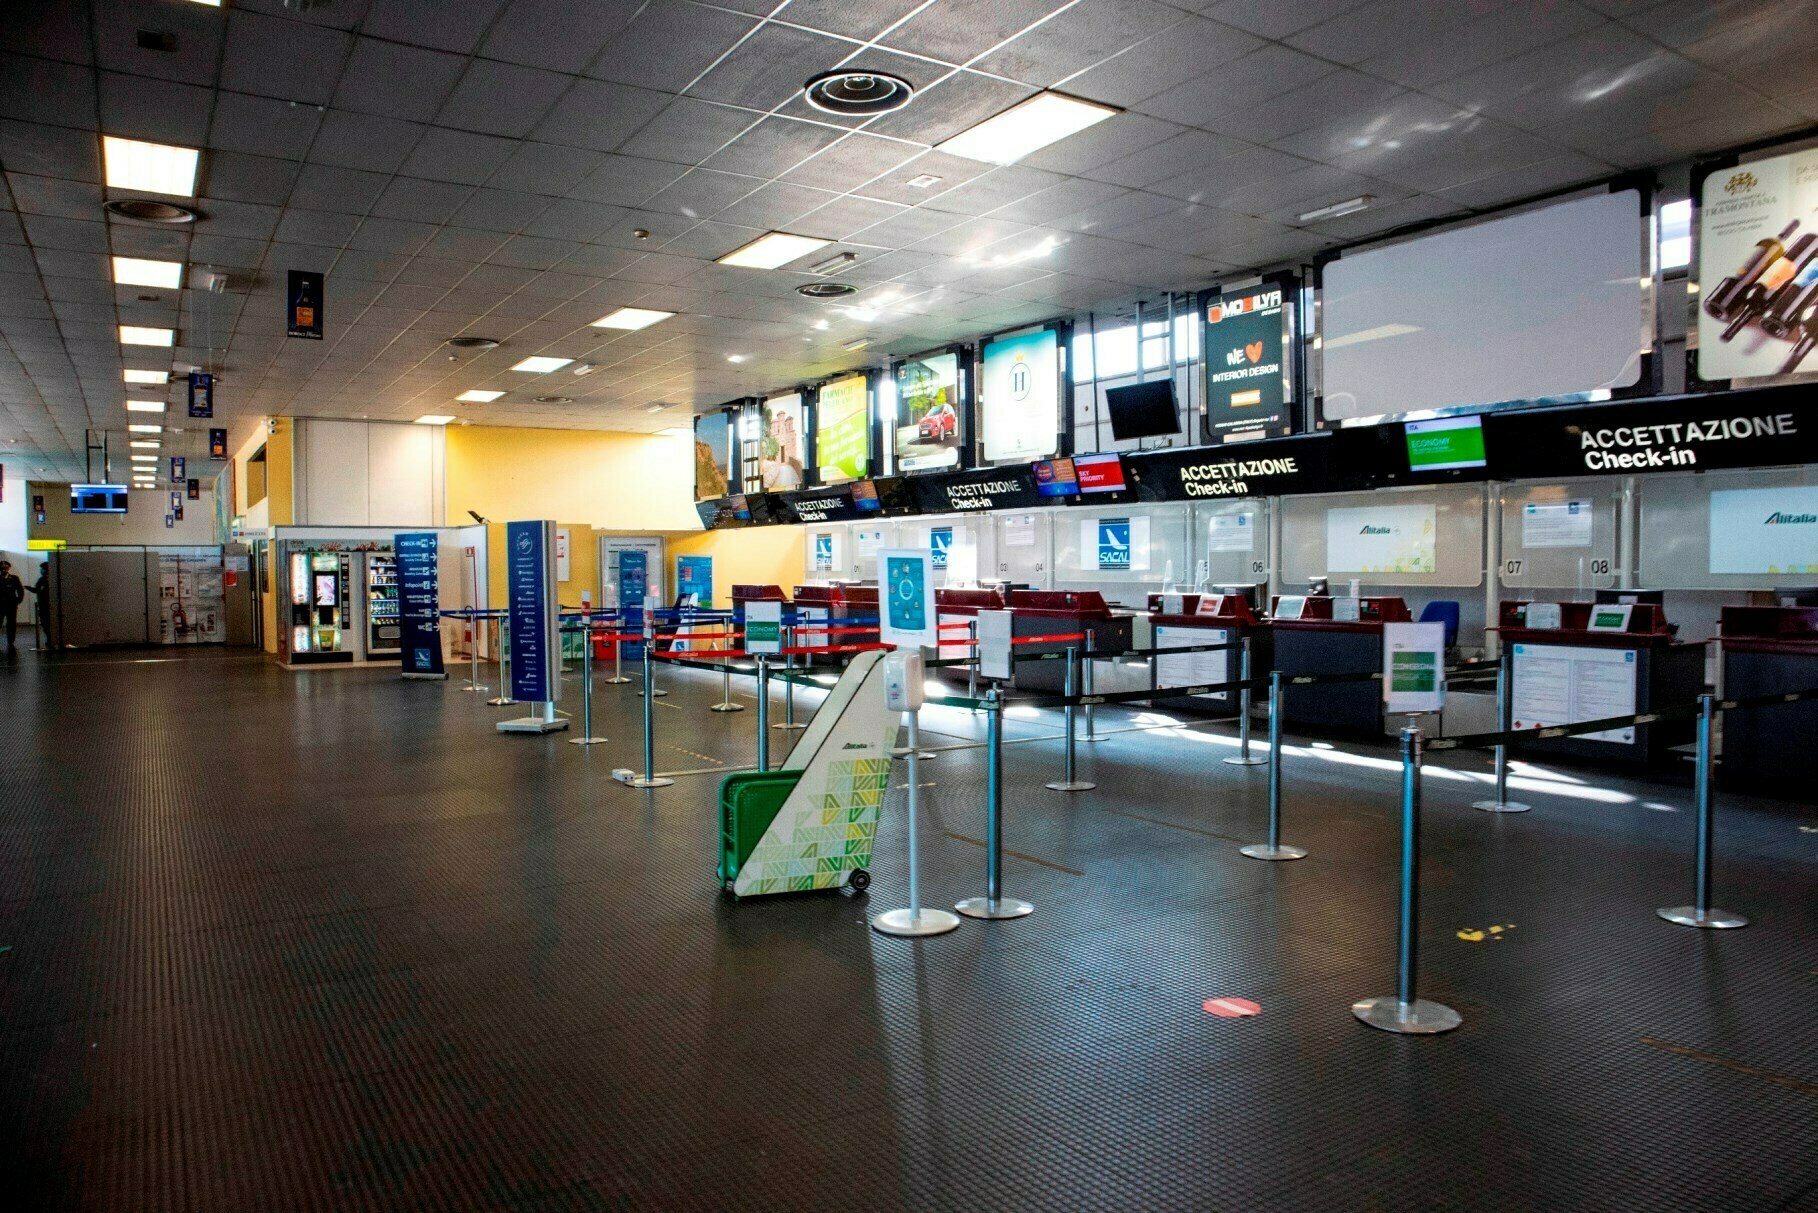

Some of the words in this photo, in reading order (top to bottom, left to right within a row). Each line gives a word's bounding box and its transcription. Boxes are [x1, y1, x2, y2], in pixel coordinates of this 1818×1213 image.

[1226, 348, 1245, 366] WE
[1213, 368, 1248, 383] INTERIOR
[1249, 363, 1279, 378] DESIGN
[1581, 413, 1797, 449] ACCETTAZIONE
[1411, 436, 1451, 448] ECONOMY
[1585, 446, 1697, 470] Check-in
[1180, 457, 1299, 481] ACCETTAZIONE
[1080, 474, 1105, 482] PRIORITY
[946, 480, 1022, 497] ACCETTAZIONE
[1185, 479, 1249, 496] Check-in
[794, 498, 845, 511] ACCETTAZIONE
[951, 497, 993, 509] Check-in
[799, 511, 828, 521] Check-in
[1764, 511, 1817, 525] Alitalia
[1360, 525, 1391, 534] Alitalia
[1100, 551, 1130, 562] SACAL
[1035, 563, 1043, 572] 04
[1252, 561, 1264, 573] 06
[1507, 561, 1522, 574] 07
[1591, 560, 1608, 574] 08
